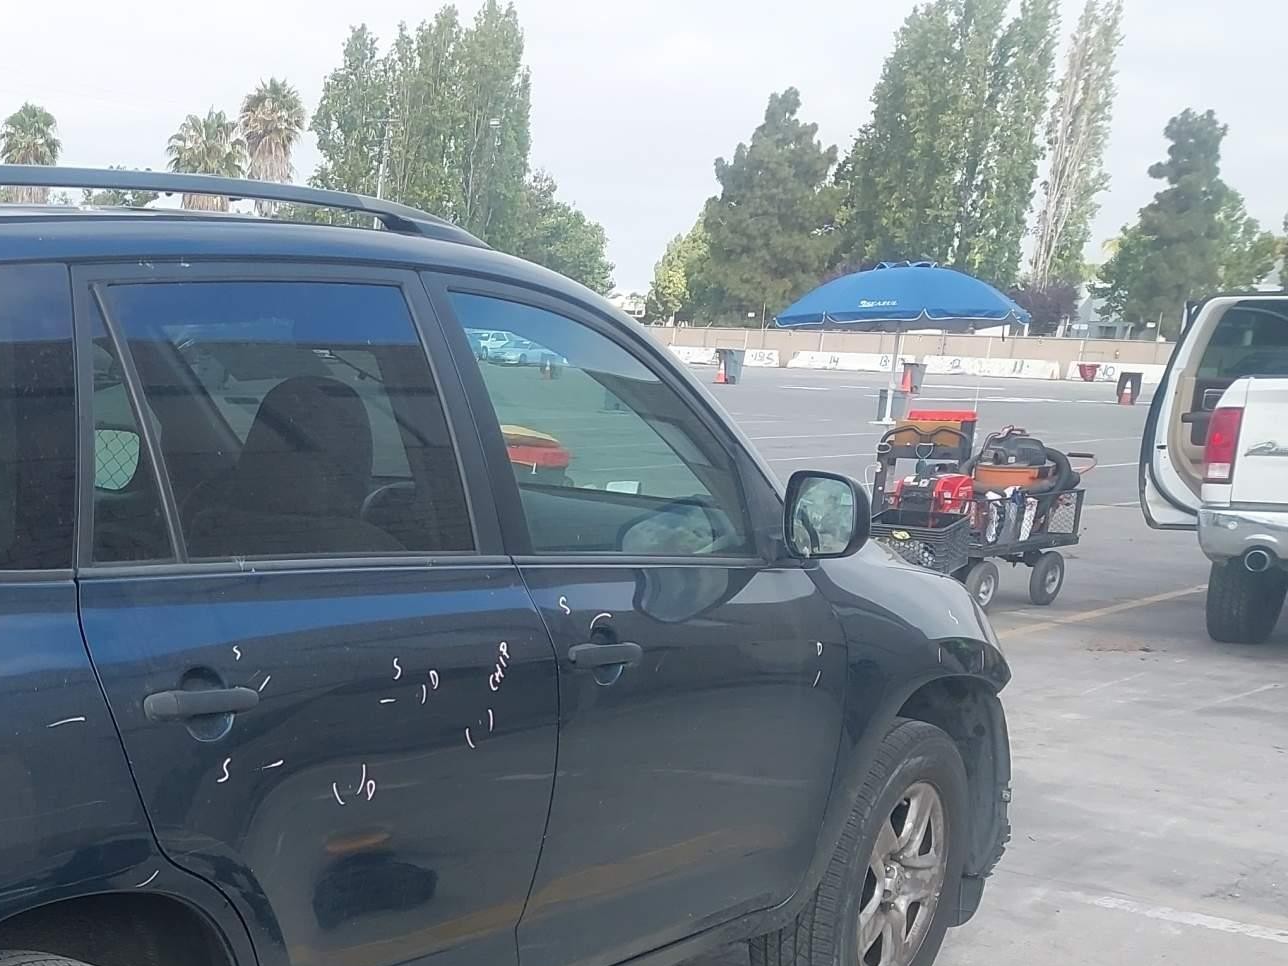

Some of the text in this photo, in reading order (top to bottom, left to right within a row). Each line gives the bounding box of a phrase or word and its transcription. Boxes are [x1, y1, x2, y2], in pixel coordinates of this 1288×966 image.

[559, 596, 571, 615] S
[232, 645, 241, 661] S
[393, 657, 402, 680] S
[489, 641, 510, 692] CHIP
[217, 757, 231, 783] S
